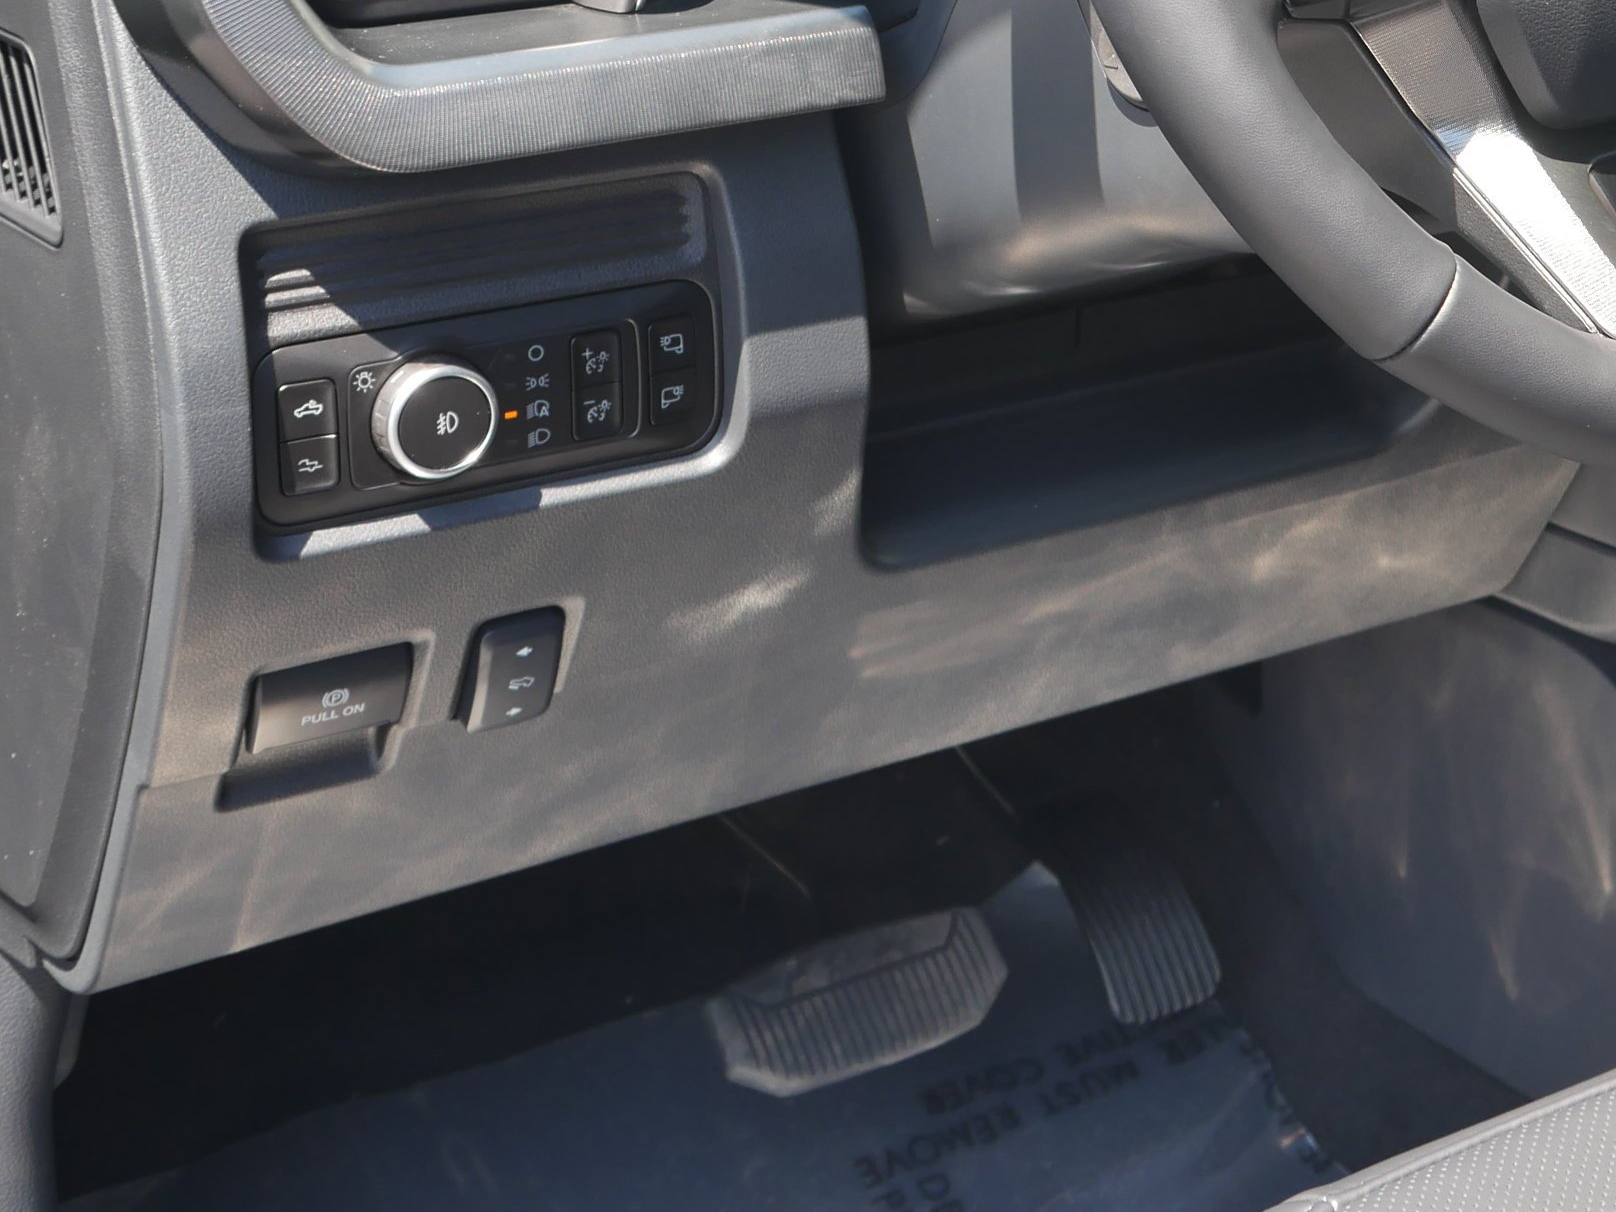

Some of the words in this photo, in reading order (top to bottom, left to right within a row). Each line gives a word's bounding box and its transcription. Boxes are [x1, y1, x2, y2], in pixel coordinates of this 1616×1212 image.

[301, 710, 339, 726] PULL
[343, 703, 366, 716] ON
[919, 1056, 1044, 1115] COVER
[1040, 1057, 1139, 1116] MUST
[855, 1103, 1021, 1188] REMOVE
